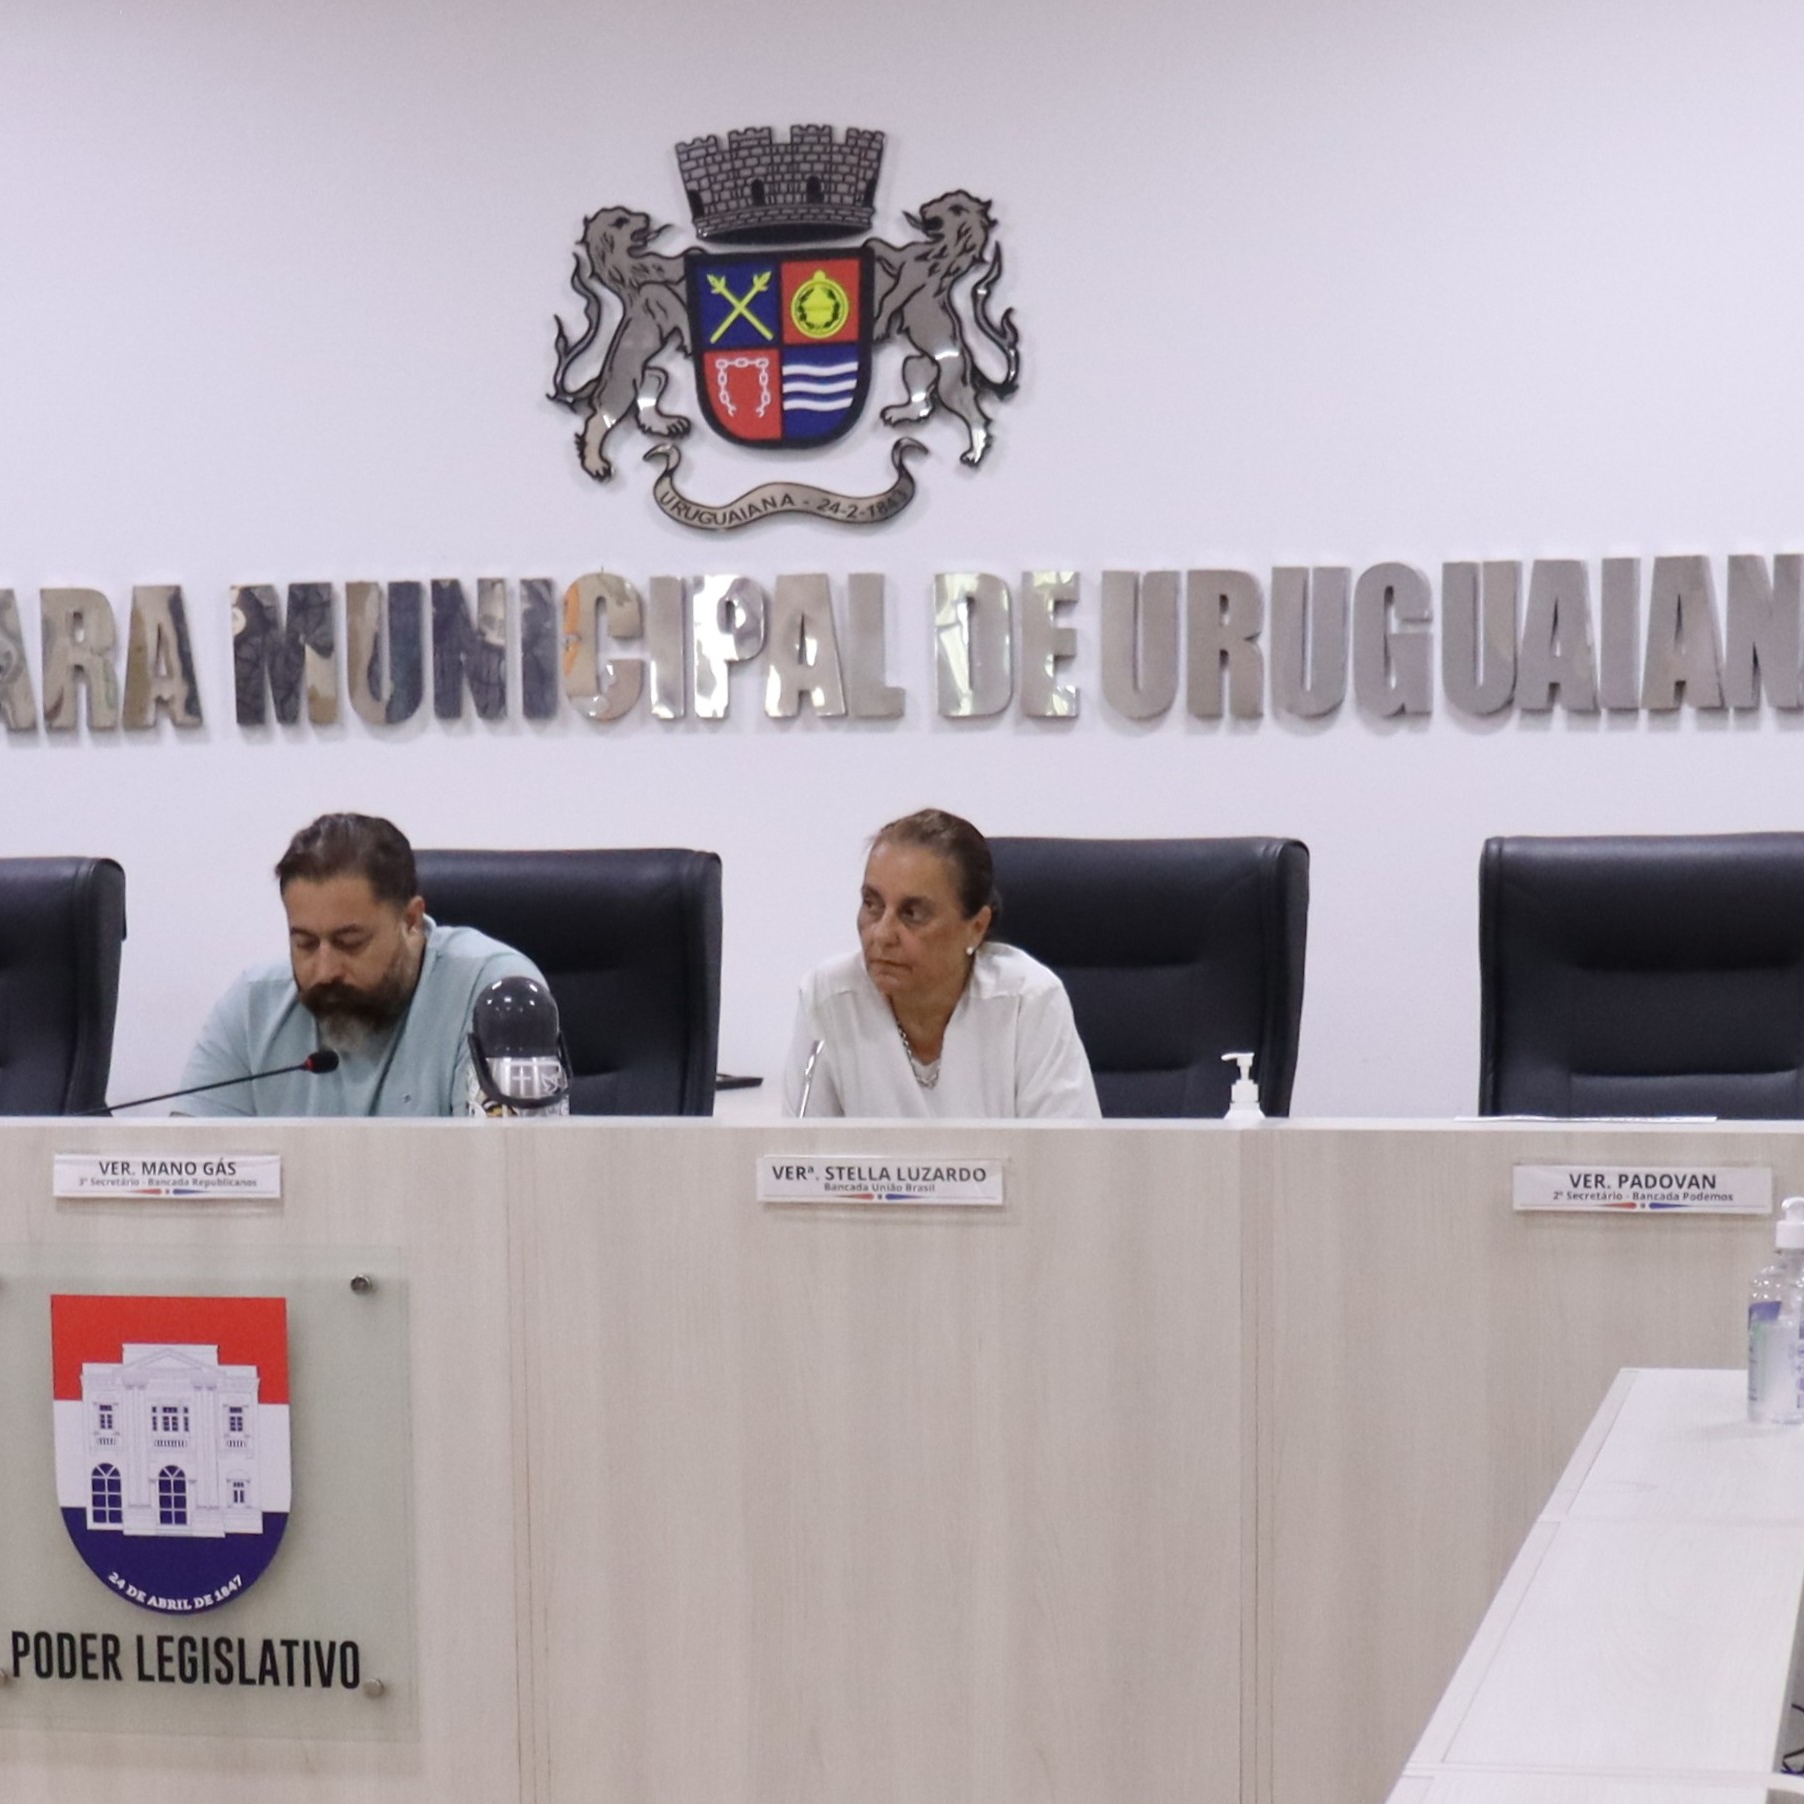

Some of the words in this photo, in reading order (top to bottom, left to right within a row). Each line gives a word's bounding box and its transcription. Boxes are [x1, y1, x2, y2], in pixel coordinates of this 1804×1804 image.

[659, 491, 794, 525] URUGUAIANA
[228, 567, 905, 728] MUNICIPAL
[934, 569, 1081, 719] DE
[100, 1161, 135, 1175] VER.
[142, 1161, 197, 1176] MANO
[203, 1157, 237, 1176] GÁS
[824, 1165, 892, 1182] STELLA
[897, 1166, 987, 1182] LUZARDO
[824, 1182, 869, 1192] Bancada
[1569, 1173, 1611, 1189] VER.
[1618, 1173, 1717, 1190] PADOVAN
[1632, 1191, 1679, 1201] Bancada
[1683, 1191, 1733, 1202] Podemos
[108, 1572, 126, 1590] 24
[125, 1584, 146, 1603] DE
[147, 1597, 192, 1611] ABRIL
[193, 1594, 214, 1610] DE
[214, 1574, 243, 1602] 1847
[11, 1630, 123, 1682] PODER
[137, 1634, 361, 1690] LEGISLATIVO
